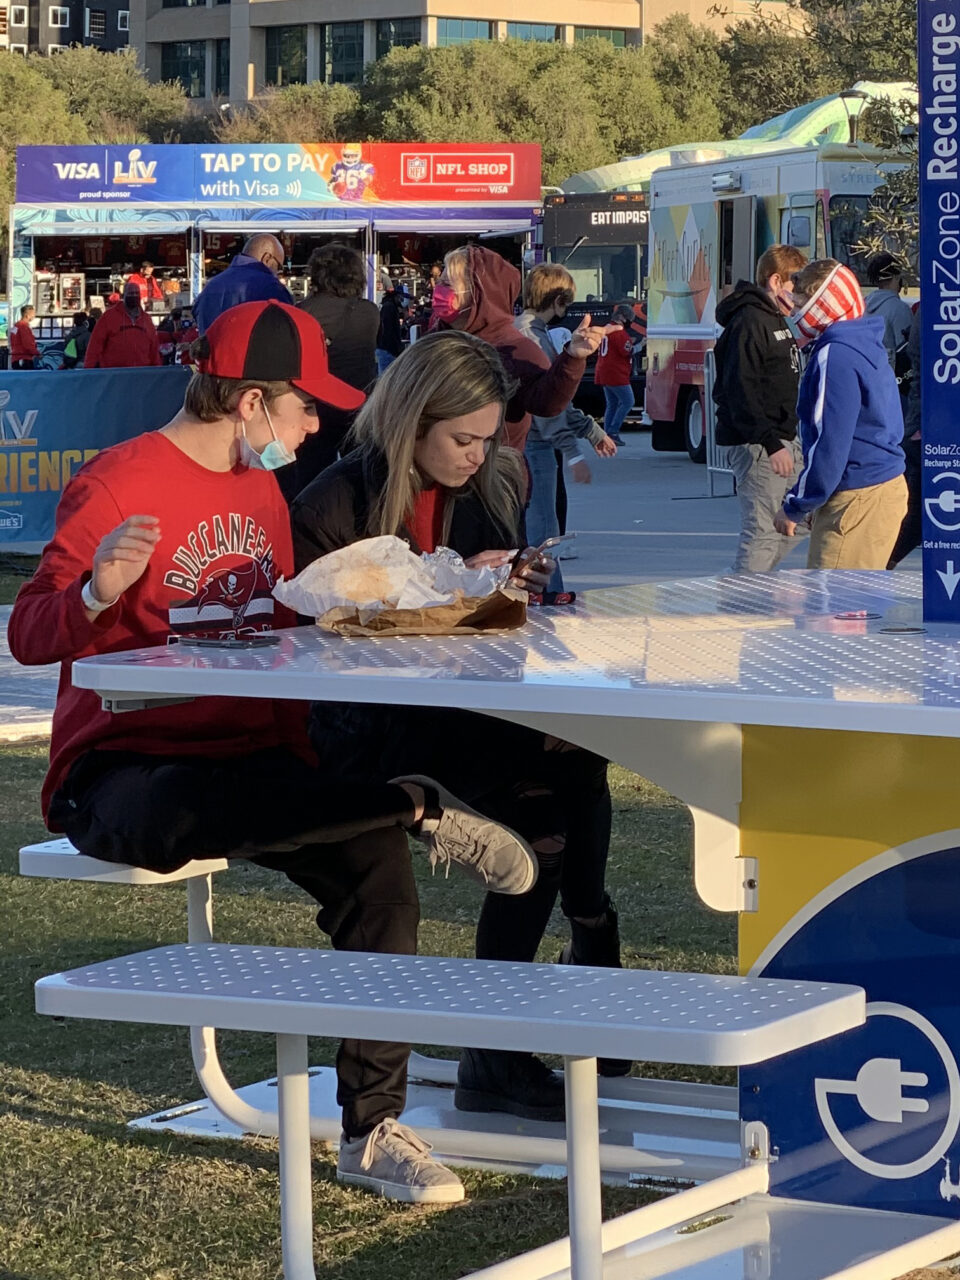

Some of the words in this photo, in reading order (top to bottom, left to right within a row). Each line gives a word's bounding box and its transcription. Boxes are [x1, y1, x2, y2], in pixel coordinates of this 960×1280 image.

[201, 153, 246, 173] TAP
[249, 152, 281, 173] TO
[287, 152, 330, 172] PAY
[53, 162, 100, 180] VISA
[436, 163, 466, 176] NFL
[468, 162, 508, 176] SHOP
[200, 180, 241, 197] with
[243, 179, 280, 197] Visa
[488, 185, 509, 194] VISA
[79, 190, 102, 200] proud
[102, 190, 131, 200] sponsor
[924, 458, 952, 468] Recharge
[923, 540, 934, 549] Get
[938, 540, 950, 549] free
